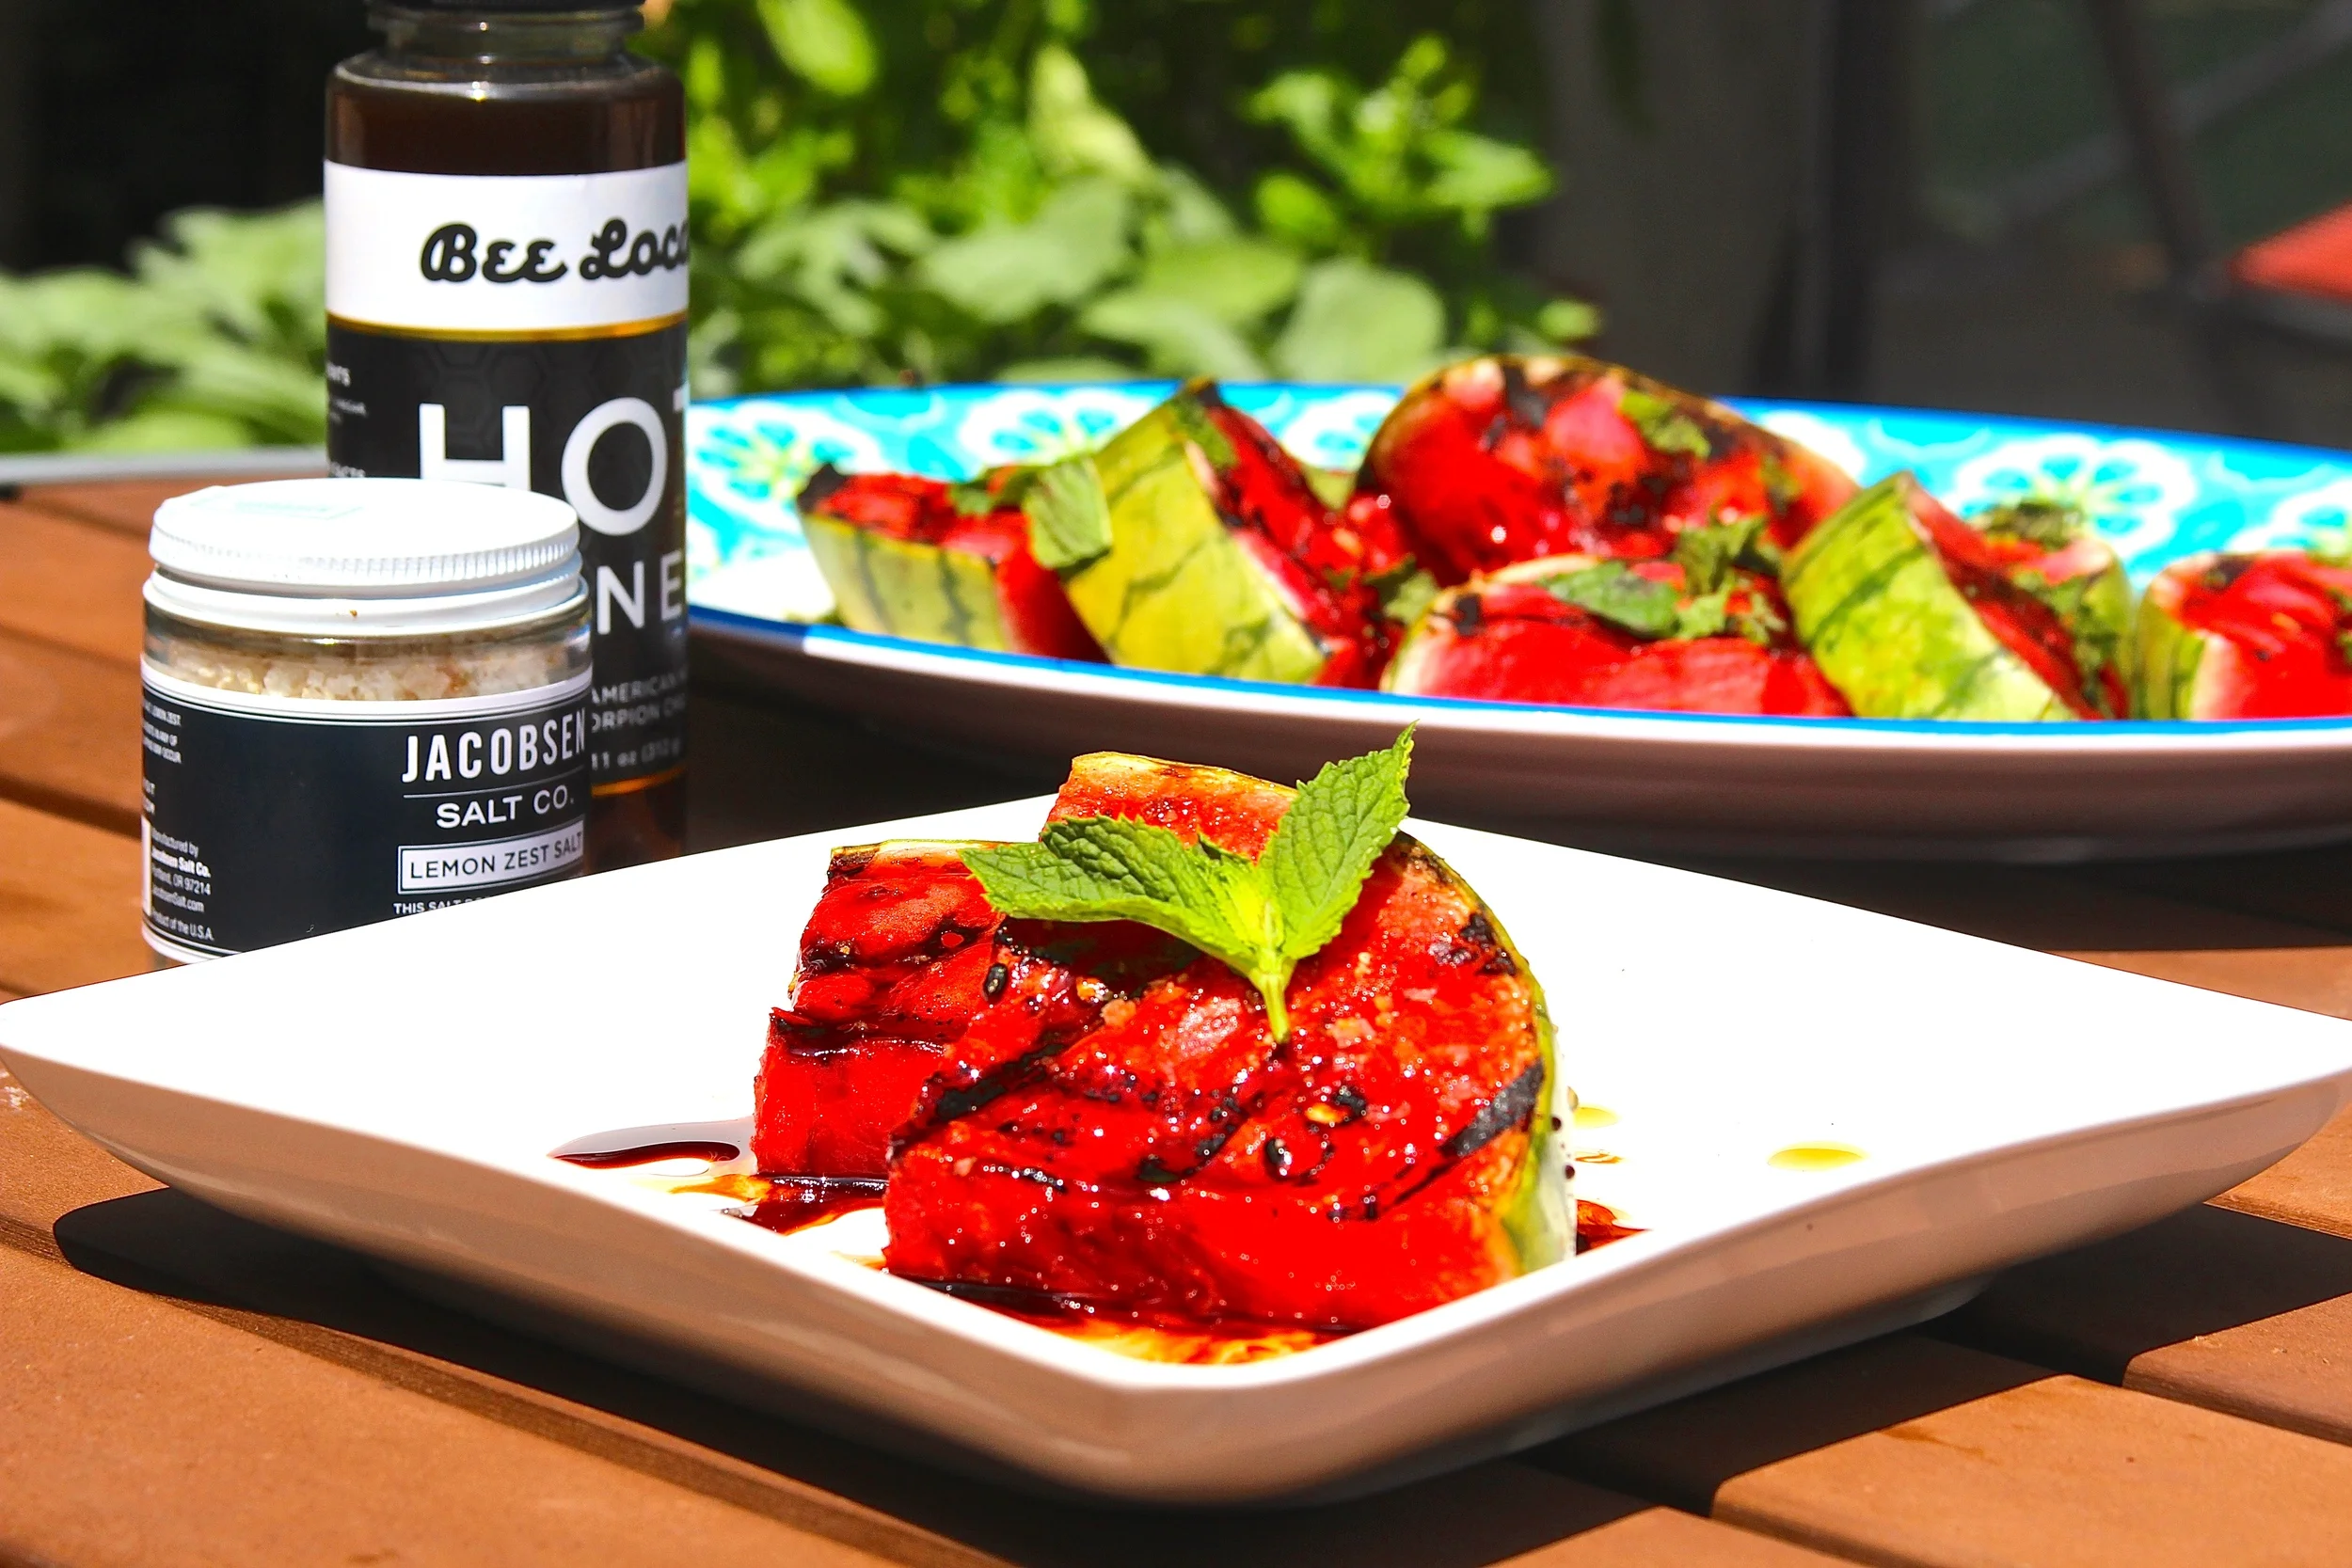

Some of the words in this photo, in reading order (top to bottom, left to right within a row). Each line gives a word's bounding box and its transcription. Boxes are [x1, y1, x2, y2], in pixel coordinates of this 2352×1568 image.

[419, 387, 688, 536] HO
[402, 707, 585, 783] JACOBSEN
[437, 795, 522, 829] SALT
[533, 784, 575, 815] CO.
[189, 842, 199, 858] by
[410, 855, 495, 879] LEMON
[503, 845, 549, 870] ZEST
[554, 832, 581, 859] SALT
[179, 857, 195, 874] Salt
[196, 862, 211, 878] Co.
[184, 878, 211, 895] 97214
[393, 902, 425, 914] THIS
